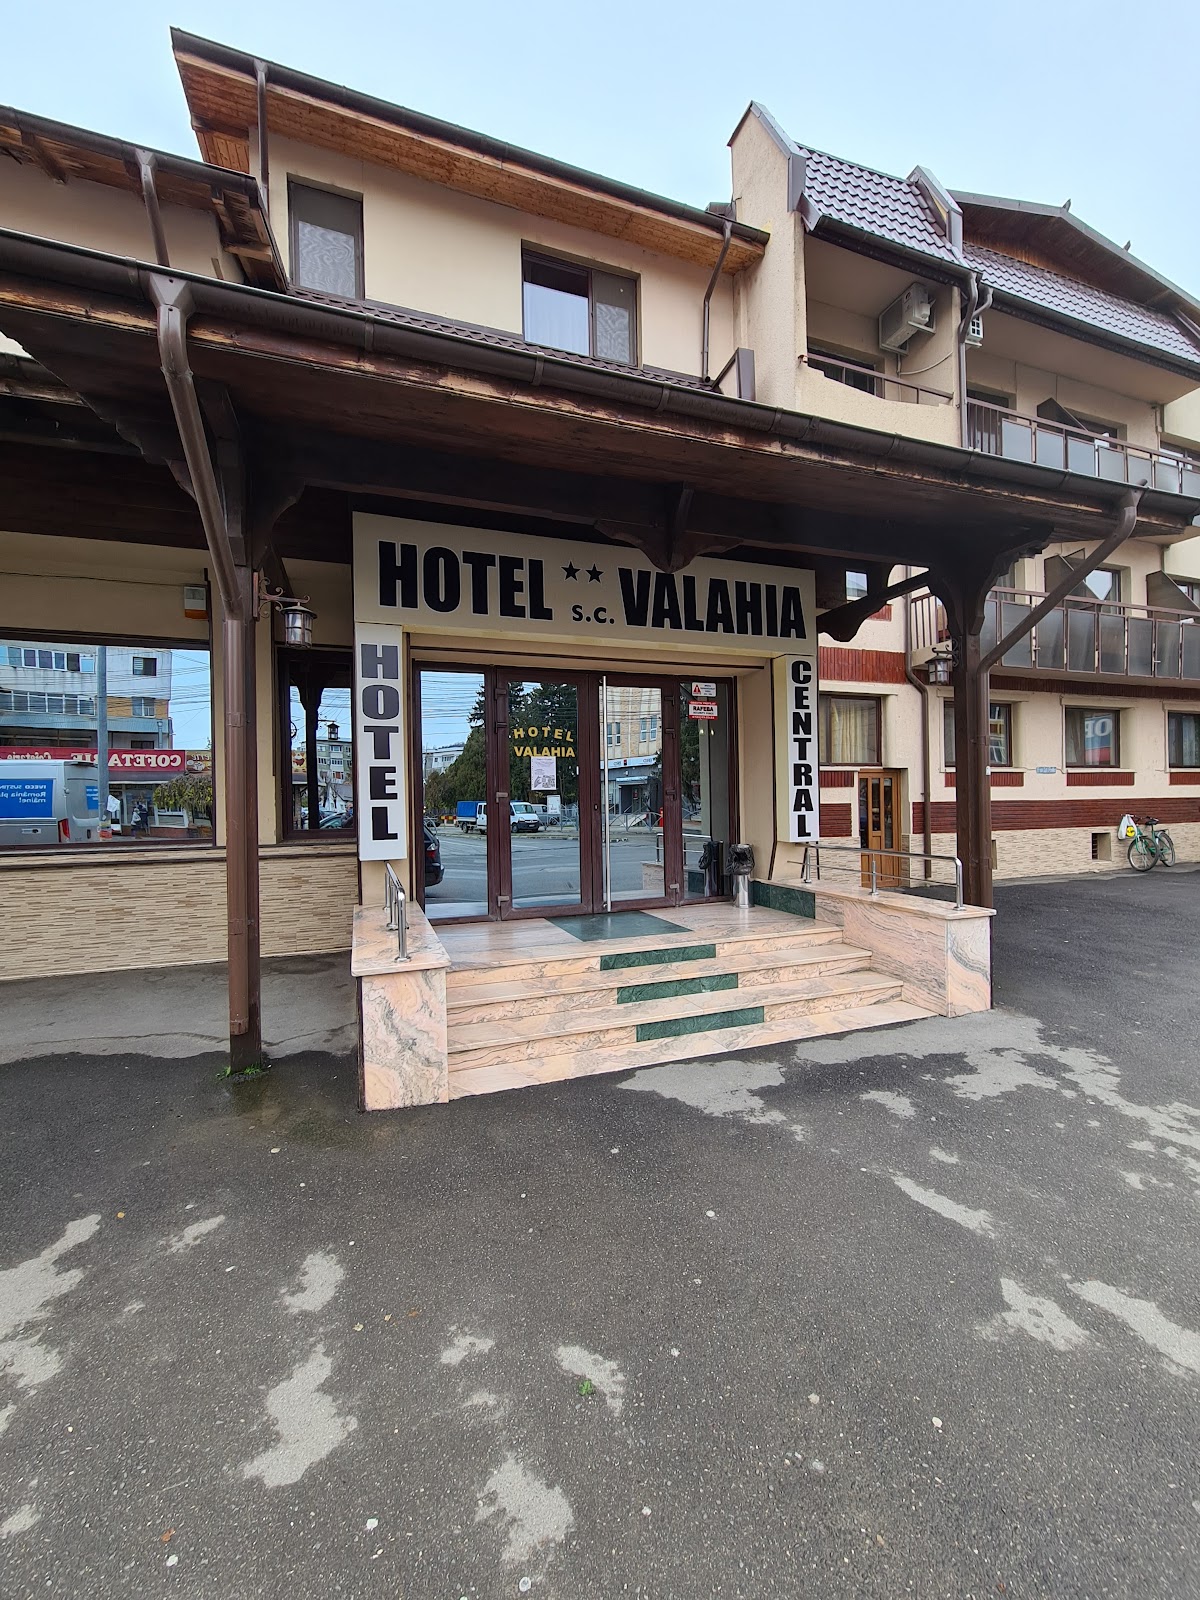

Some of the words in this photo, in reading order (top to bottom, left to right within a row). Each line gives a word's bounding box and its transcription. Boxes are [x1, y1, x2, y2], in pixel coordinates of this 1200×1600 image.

[378, 540, 554, 621] HOTEL
[571, 604, 615, 625] S.C.
[617, 567, 807, 640] VALAHIA
[361, 643, 400, 841] HOTEL
[513, 726, 575, 742] HOTEL
[513, 746, 576, 758] VALAHIA
[791, 660, 814, 838] CENTRAL
